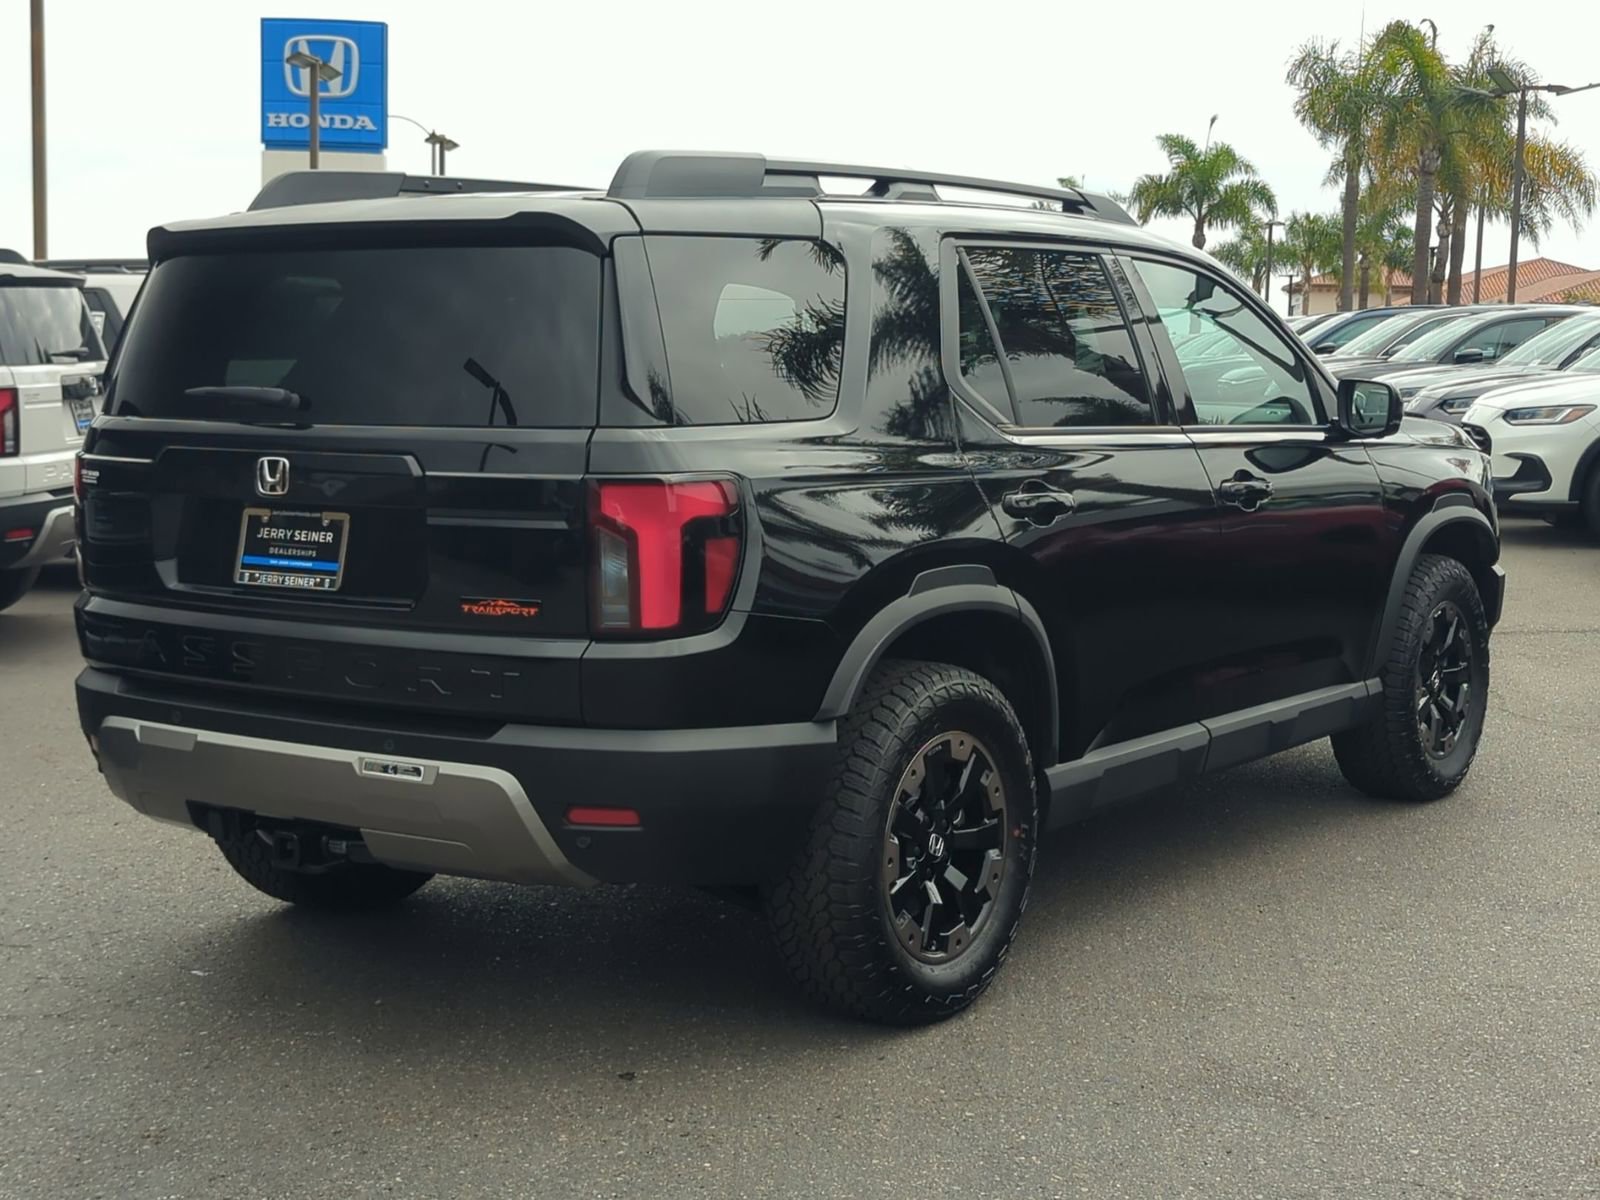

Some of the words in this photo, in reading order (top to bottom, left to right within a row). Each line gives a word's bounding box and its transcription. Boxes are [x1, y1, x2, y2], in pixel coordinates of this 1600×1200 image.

[266, 112, 378, 130] HONDA
[257, 527, 293, 539] JERRY
[294, 530, 334, 543] SEINER
[269, 547, 317, 557] DEALERSHIPS
[257, 575, 285, 585] JERRY
[285, 576, 315, 587] SEINER
[461, 604, 539, 617] TRAILSPORT
